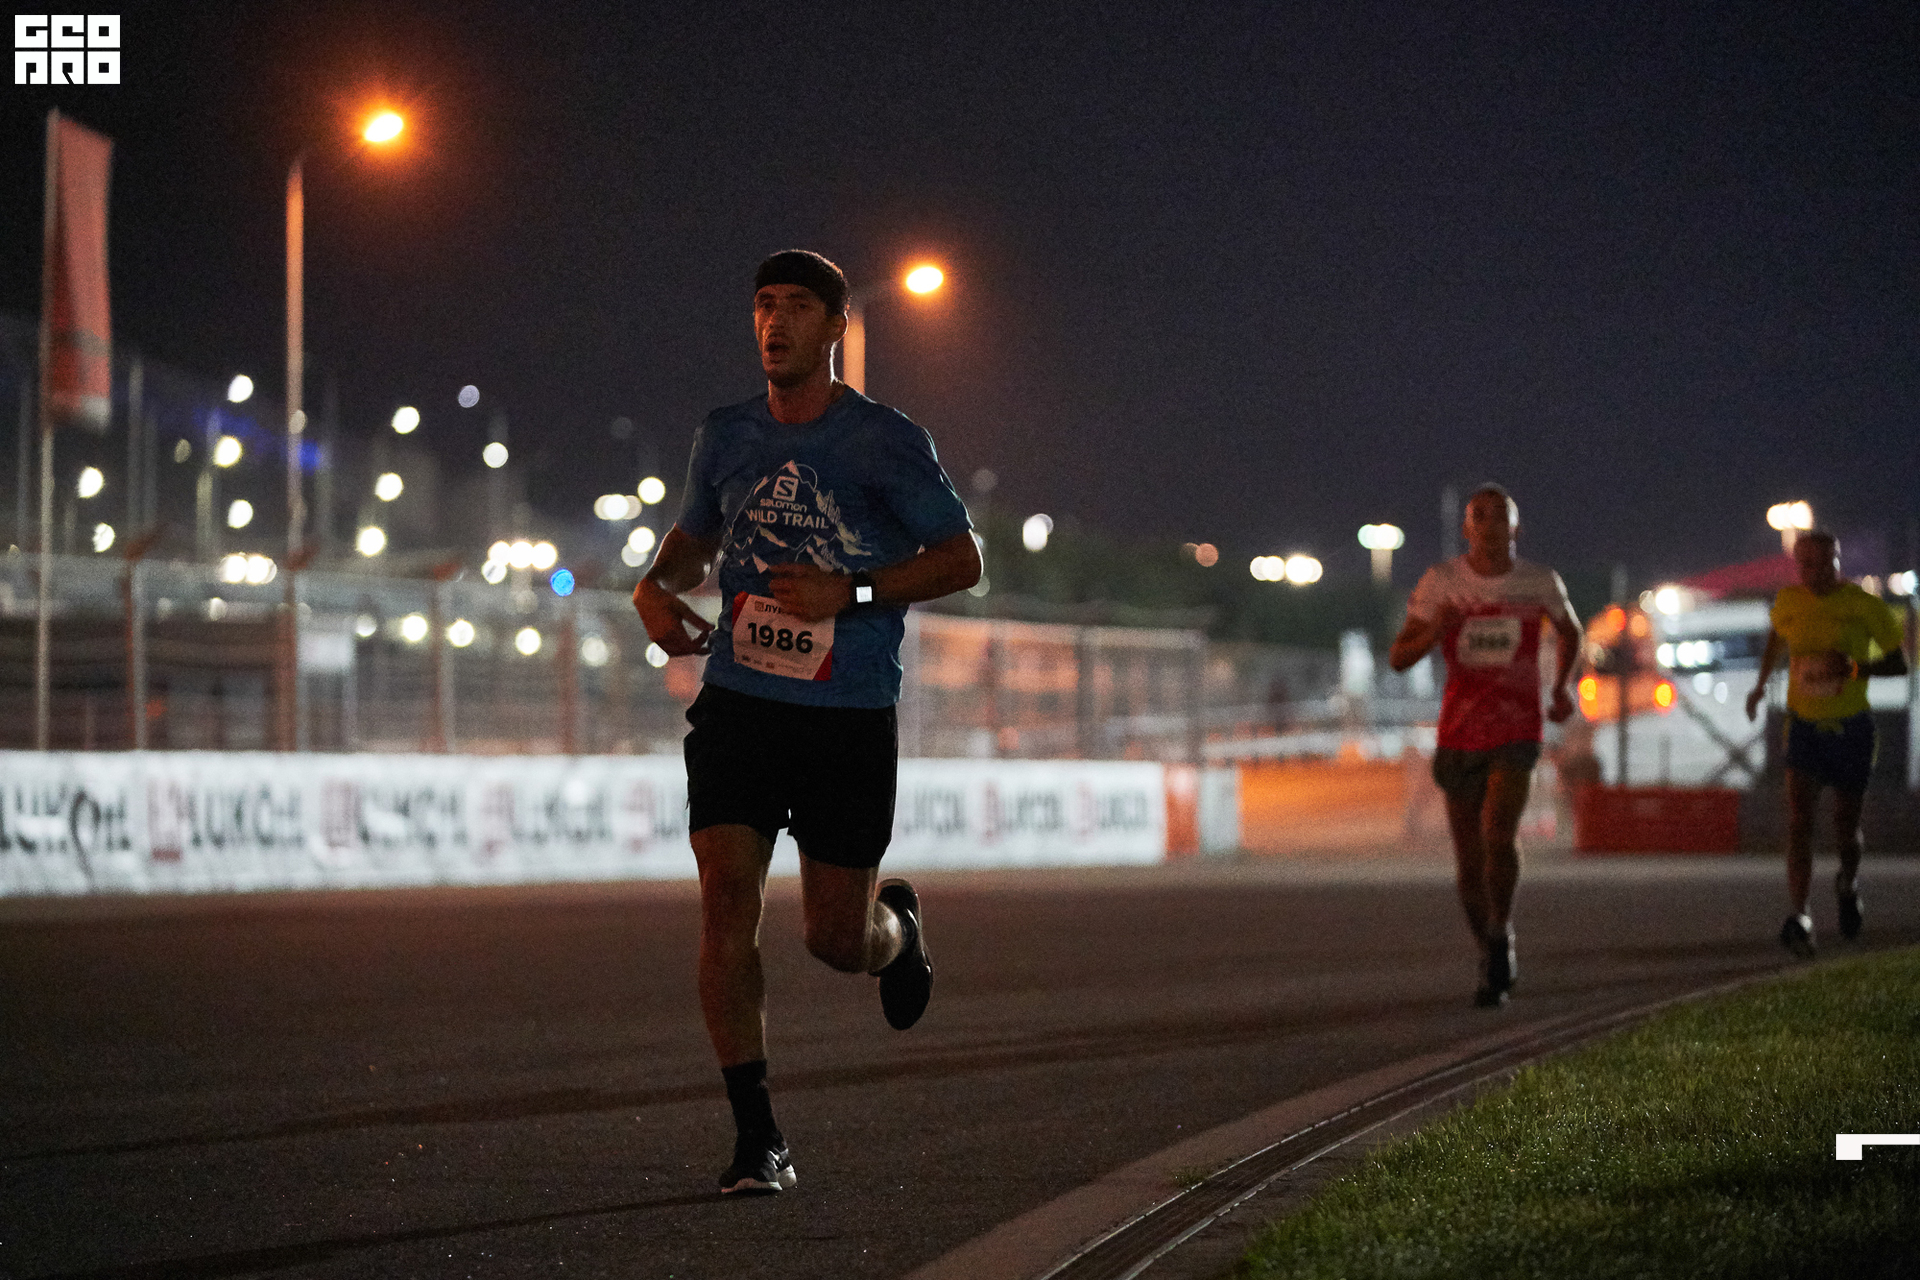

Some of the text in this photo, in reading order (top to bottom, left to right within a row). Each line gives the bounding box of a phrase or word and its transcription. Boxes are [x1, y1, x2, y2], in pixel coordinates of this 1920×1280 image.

[745, 509, 829, 529] WILD TRAIL
[748, 622, 813, 654] 1986
